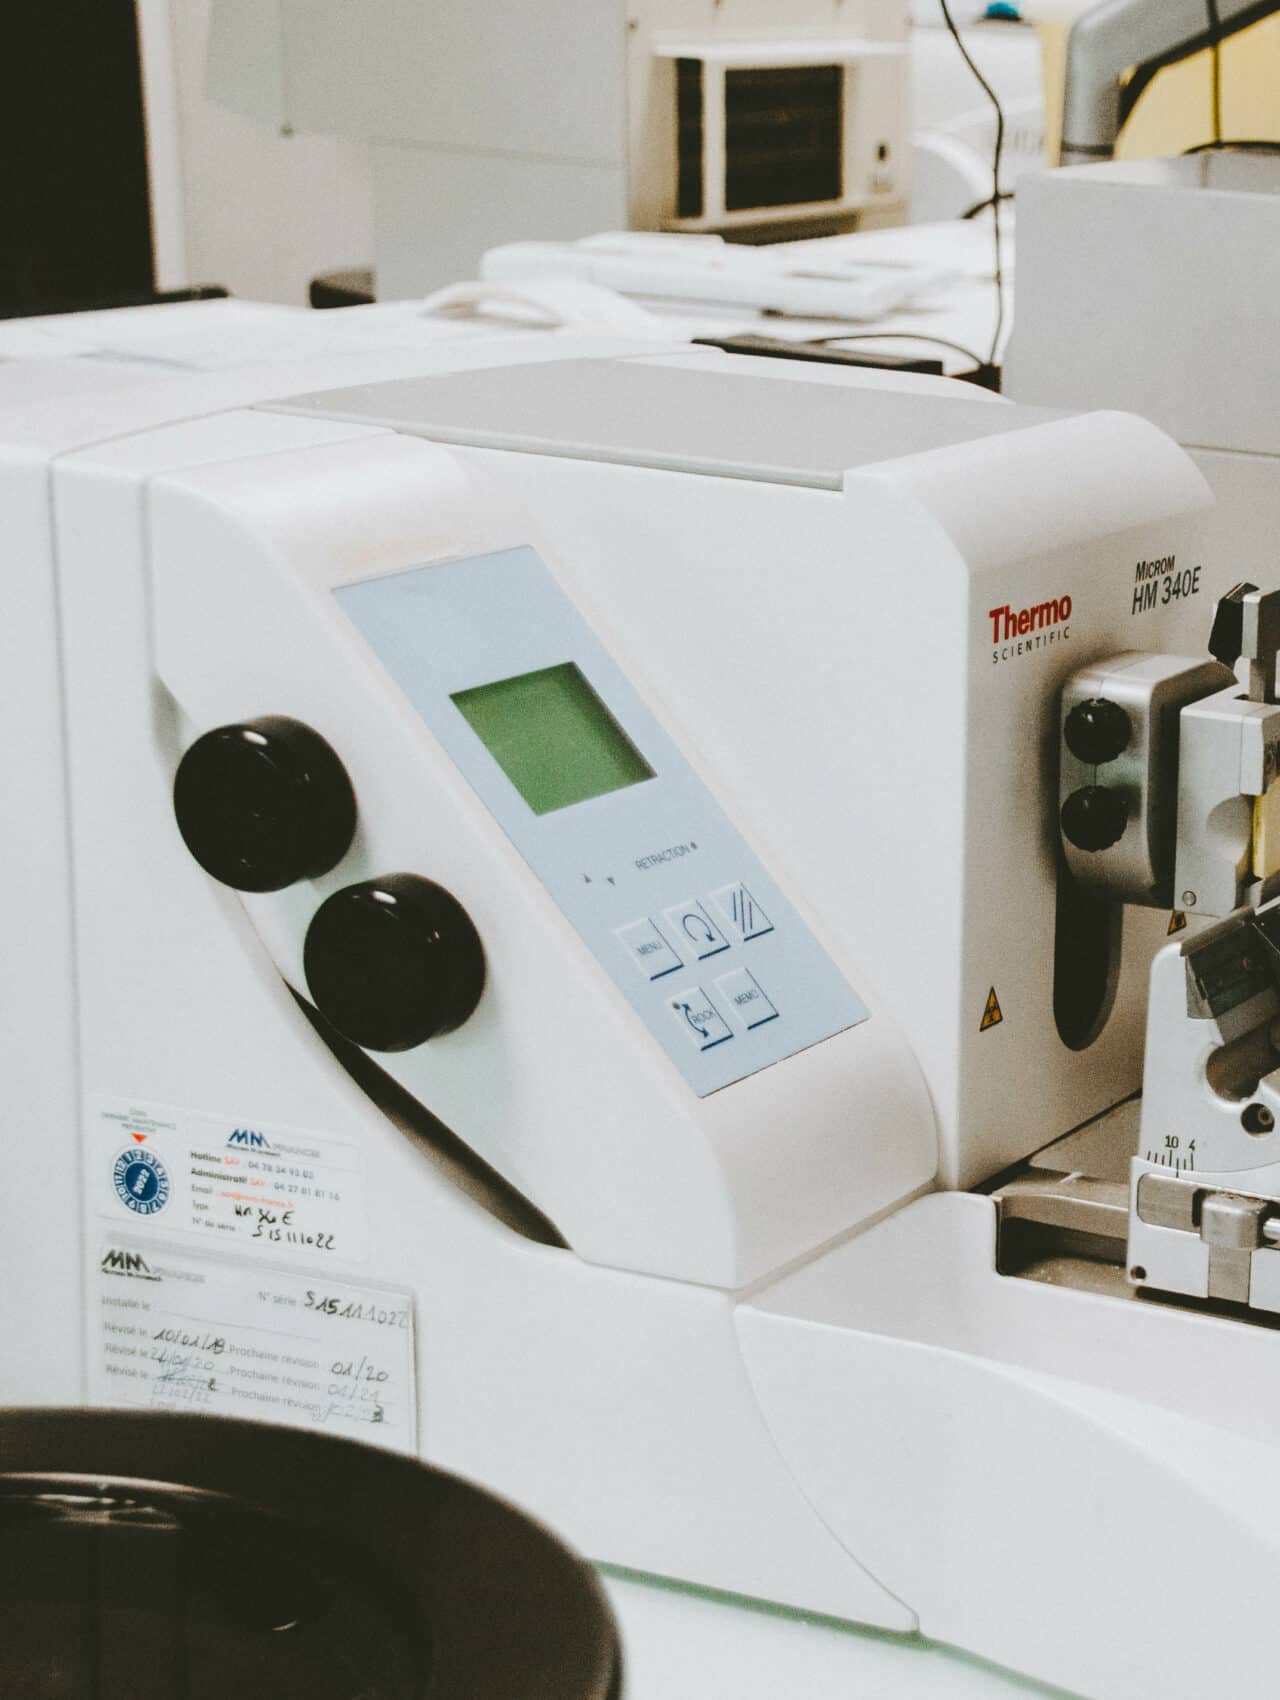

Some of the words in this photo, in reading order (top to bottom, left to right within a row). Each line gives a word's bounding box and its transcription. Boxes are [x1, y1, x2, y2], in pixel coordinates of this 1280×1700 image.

[1135, 555, 1175, 583] MICROM
[1131, 580, 1159, 615] HM
[1161, 566, 1201, 605] 340E
[989, 595, 1072, 643] Thermo
[992, 626, 1071, 664] SCIENTIFIC
[635, 843, 691, 870] RETRACTION
[1165, 1134, 1179, 1149] 10
[1188, 1139, 1196, 1151] 4
[190, 1150, 222, 1164] Hotline
[190, 1168, 247, 1185] Administratif
[331, 1355, 389, 1382] 01/20
